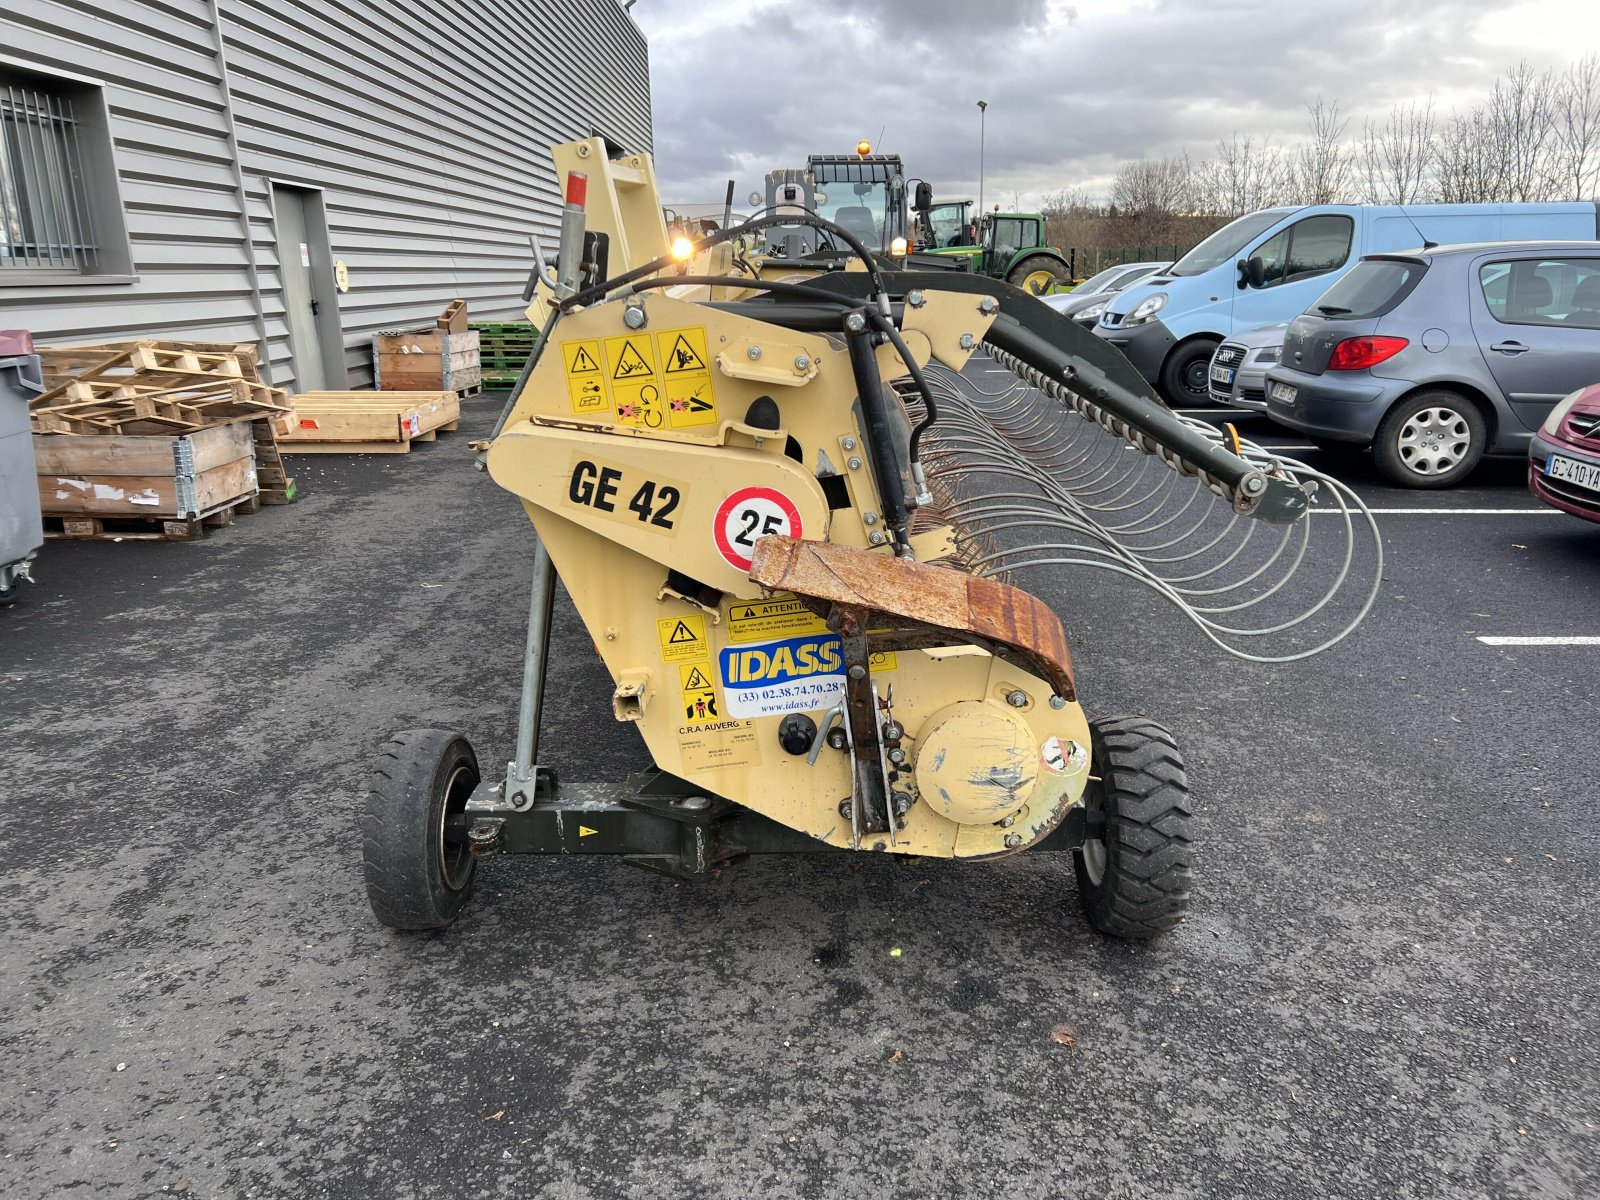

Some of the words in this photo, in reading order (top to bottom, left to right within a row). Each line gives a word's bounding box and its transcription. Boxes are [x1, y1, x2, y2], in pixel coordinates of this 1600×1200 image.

[569, 460, 622, 513] GE
[628, 480, 681, 530] 42
[734, 509, 783, 547] 25
[728, 641, 842, 684] IDASS
[738, 692, 759, 704] (33)
[762, 682, 839, 699] 02.38.74.70.28
[761, 698, 819, 712] www.idass.fr
[679, 725, 703, 735] C.R.A.
[705, 720, 752, 731] AUVERGE
